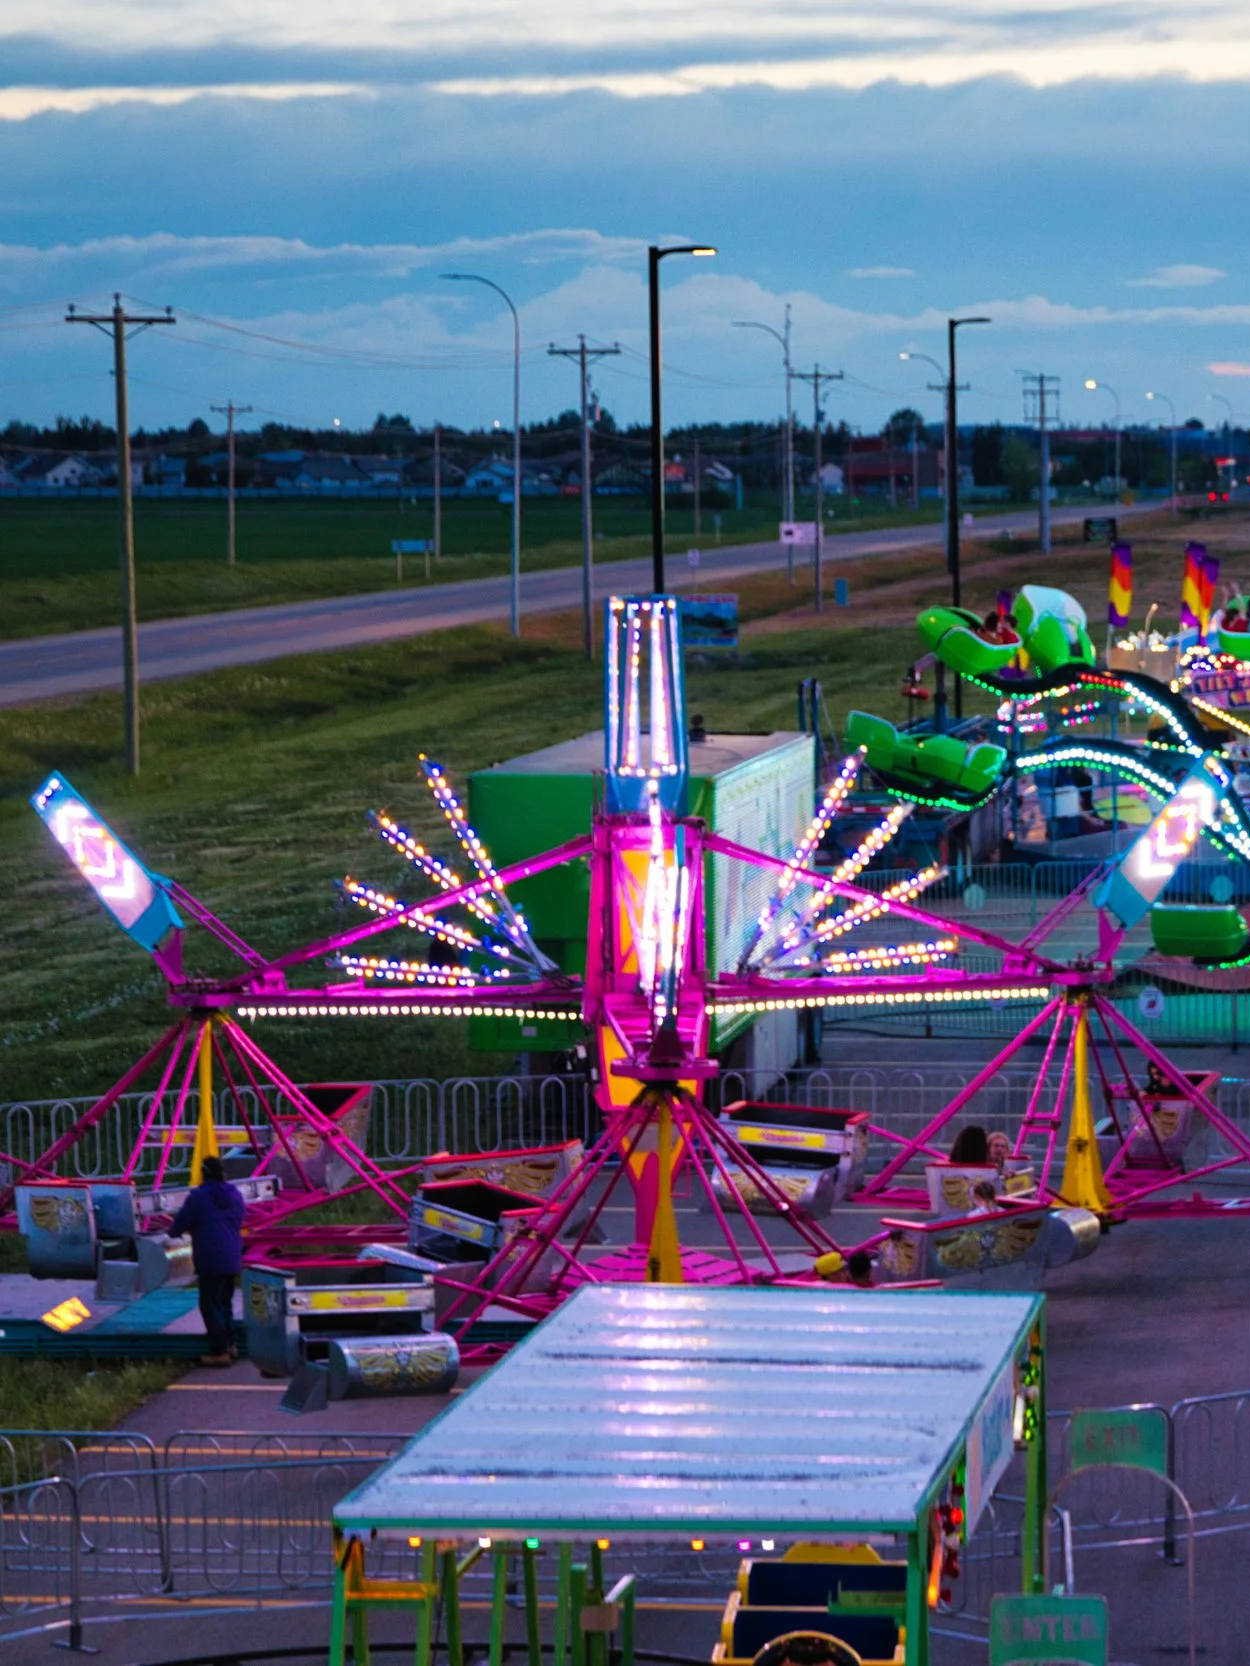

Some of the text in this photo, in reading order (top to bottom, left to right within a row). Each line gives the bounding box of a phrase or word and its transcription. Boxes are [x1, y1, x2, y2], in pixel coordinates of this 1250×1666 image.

[1194, 673, 1235, 692] TILT
[1084, 1424, 1140, 1450] EXIT
[1003, 1613, 1098, 1642] ENTER
